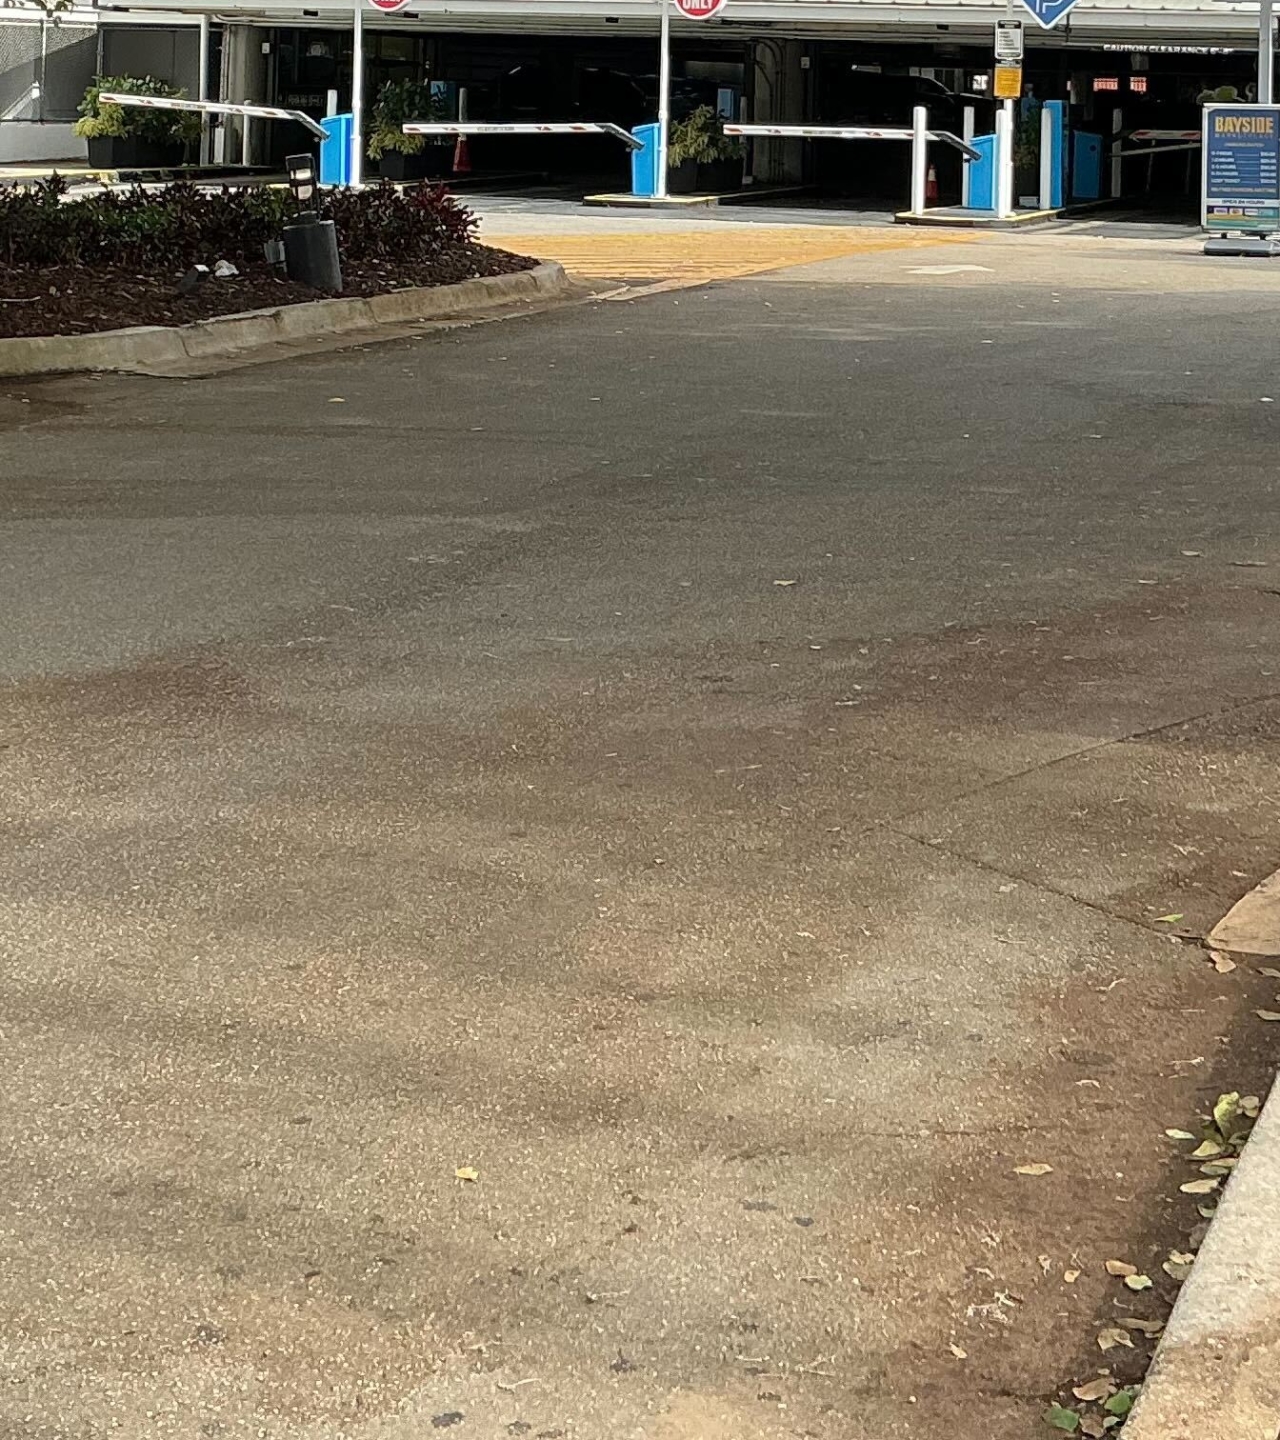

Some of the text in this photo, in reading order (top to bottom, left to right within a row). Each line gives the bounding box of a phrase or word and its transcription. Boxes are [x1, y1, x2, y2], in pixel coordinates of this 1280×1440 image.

[1103, 44, 1147, 52] CAUTION
[1148, 45, 1209, 55] CLEARANCE
[1215, 116, 1274, 133] BAYSIDE
